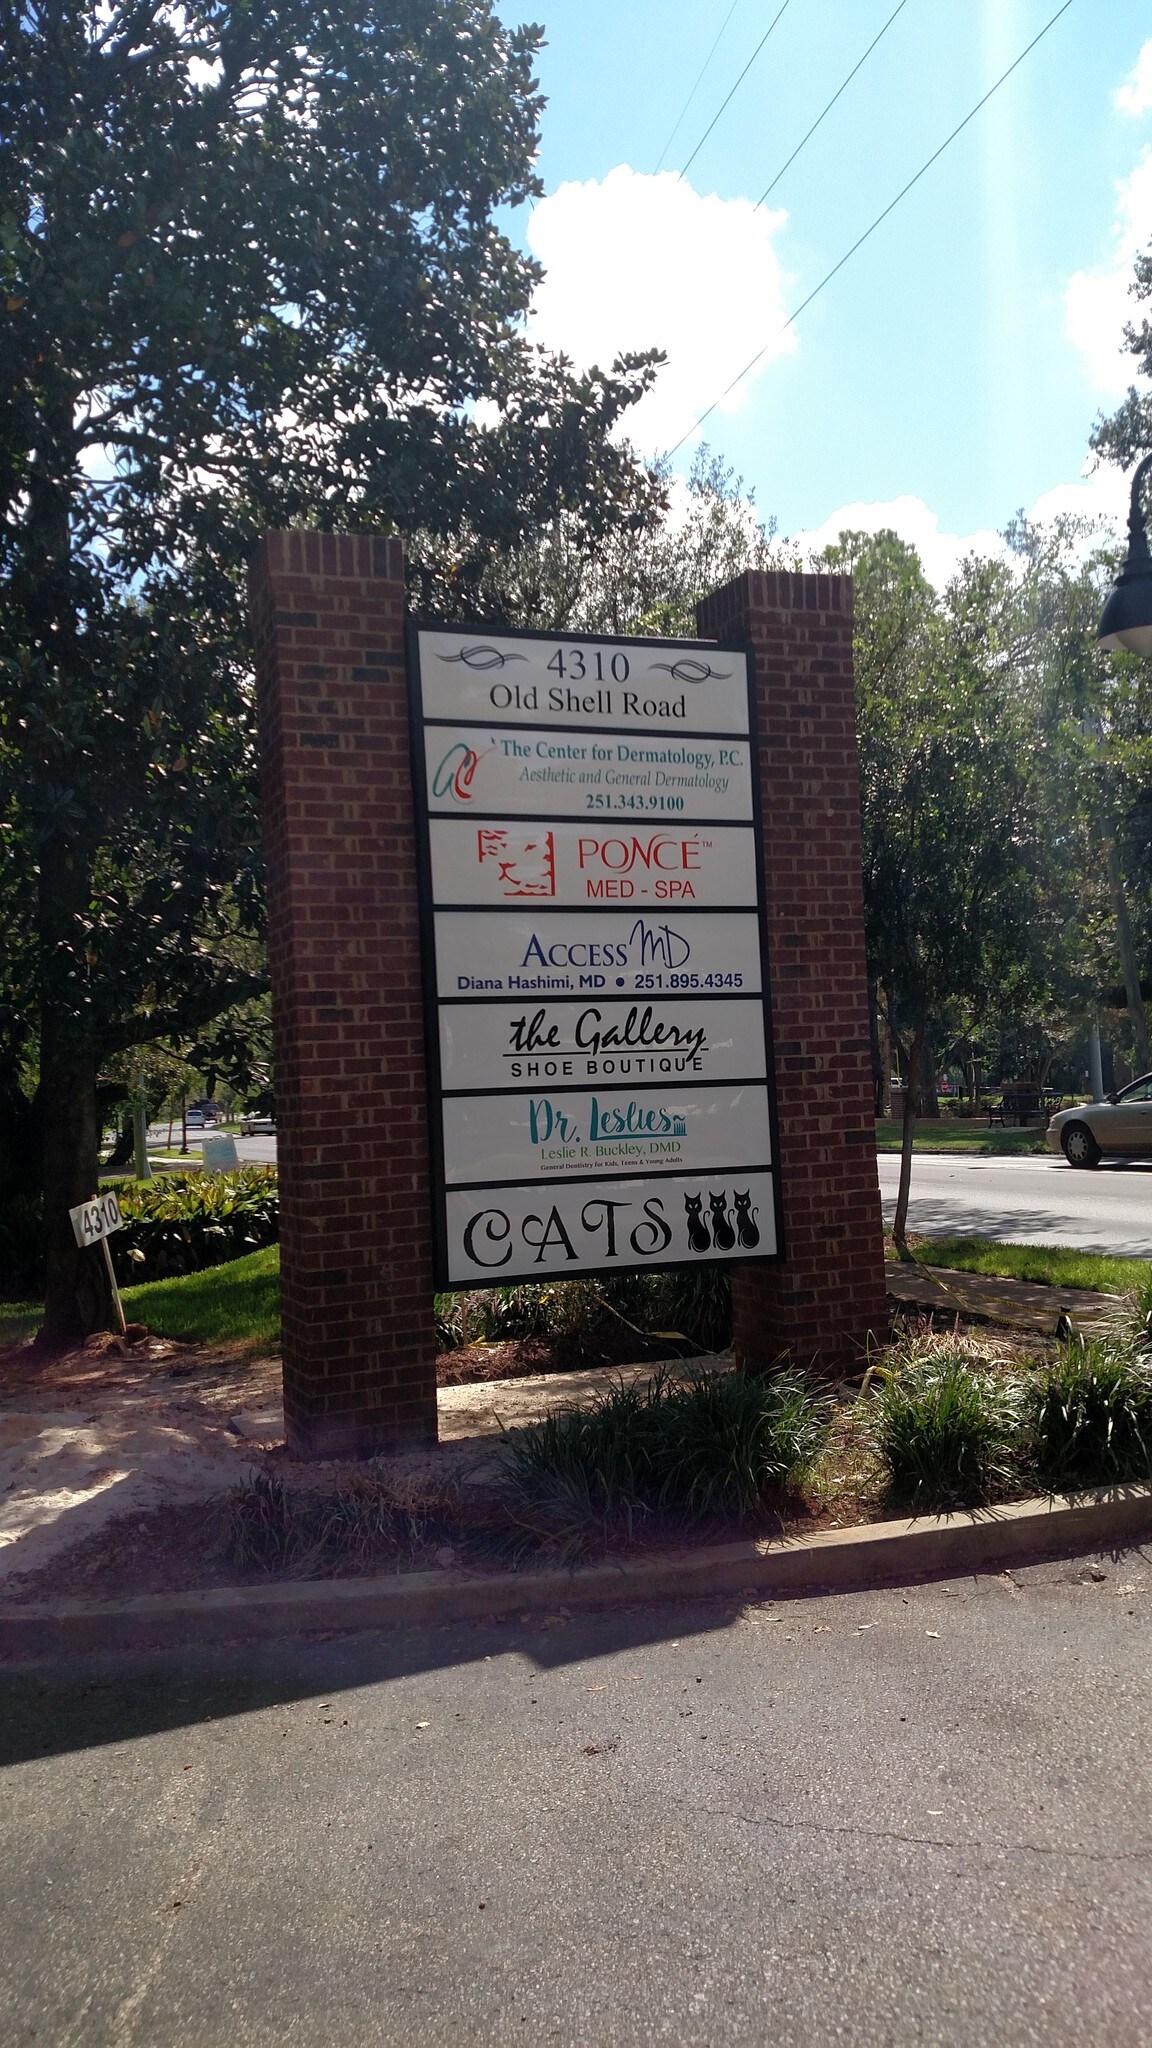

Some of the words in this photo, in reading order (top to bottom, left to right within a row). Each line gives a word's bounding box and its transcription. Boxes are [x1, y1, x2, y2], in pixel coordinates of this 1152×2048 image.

[547, 648, 630, 683] 4310
[489, 684, 538, 711] Old
[548, 687, 611, 715] Shell
[622, 691, 687, 718] Road
[500, 739, 531, 758] The
[536, 742, 589, 761] Center
[592, 744, 612, 761] for
[617, 746, 715, 769] Dermatology,
[519, 766, 575, 784] Aesthetic
[578, 769, 601, 785] and
[605, 770, 651, 786] General
[655, 773, 730, 793] Dermatology
[586, 794, 684, 812] 251.343.9100
[586, 879, 634, 898] MED
[655, 880, 696, 899] SPA
[519, 932, 628, 968] ACCESS
[457, 976, 503, 990] Diana
[508, 975, 574, 991] Hashimi,
[579, 975, 606, 989] MD
[635, 973, 743, 989] 251.895.4345
[509, 1008, 561, 1051] the
[575, 1006, 707, 1062] Gallery
[511, 1060, 574, 1078] SHOE
[587, 1056, 703, 1075] BOUTIQUE
[529, 1098, 581, 1145] Dr.
[540, 1163, 565, 1171] General
[566, 1162, 593, 1170] Dentistry
[621, 1159, 638, 1167] Teens
[645, 1158, 664, 1166] Young
[665, 1156, 683, 1164] Adults
[541, 1145, 576, 1160] Leslie
[580, 1146, 592, 1157] R.
[596, 1143, 646, 1158] Buckley,
[650, 1141, 681, 1154] DMD
[83, 1197, 118, 1237] 4310
[463, 1196, 673, 1268] CATS
